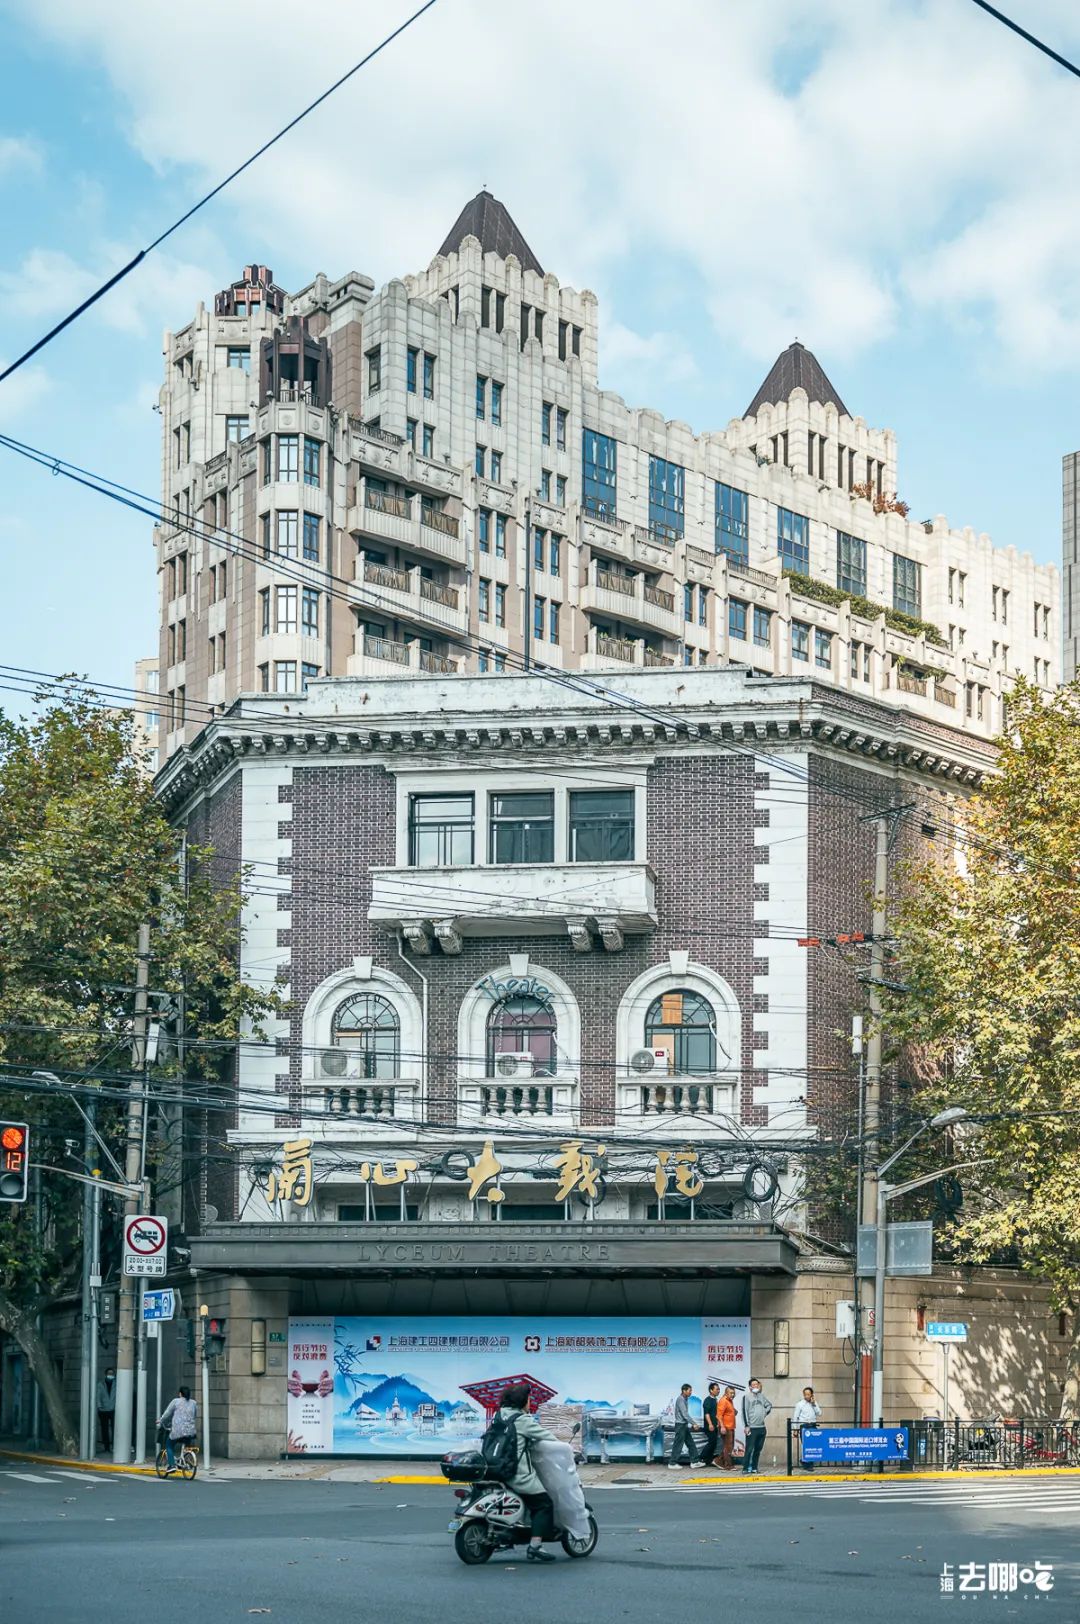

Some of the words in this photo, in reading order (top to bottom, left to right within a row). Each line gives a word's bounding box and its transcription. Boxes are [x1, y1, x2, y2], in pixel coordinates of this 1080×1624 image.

[475, 975, 556, 1002] Theater
[6, 1151, 22, 1171] 12
[357, 1245, 465, 1262] LYCEUM
[488, 1245, 610, 1262] THEATRE
[128, 1265, 163, 1273] 大型号牌
[388, 1336, 510, 1347] 上海建工四建集团有限公司
